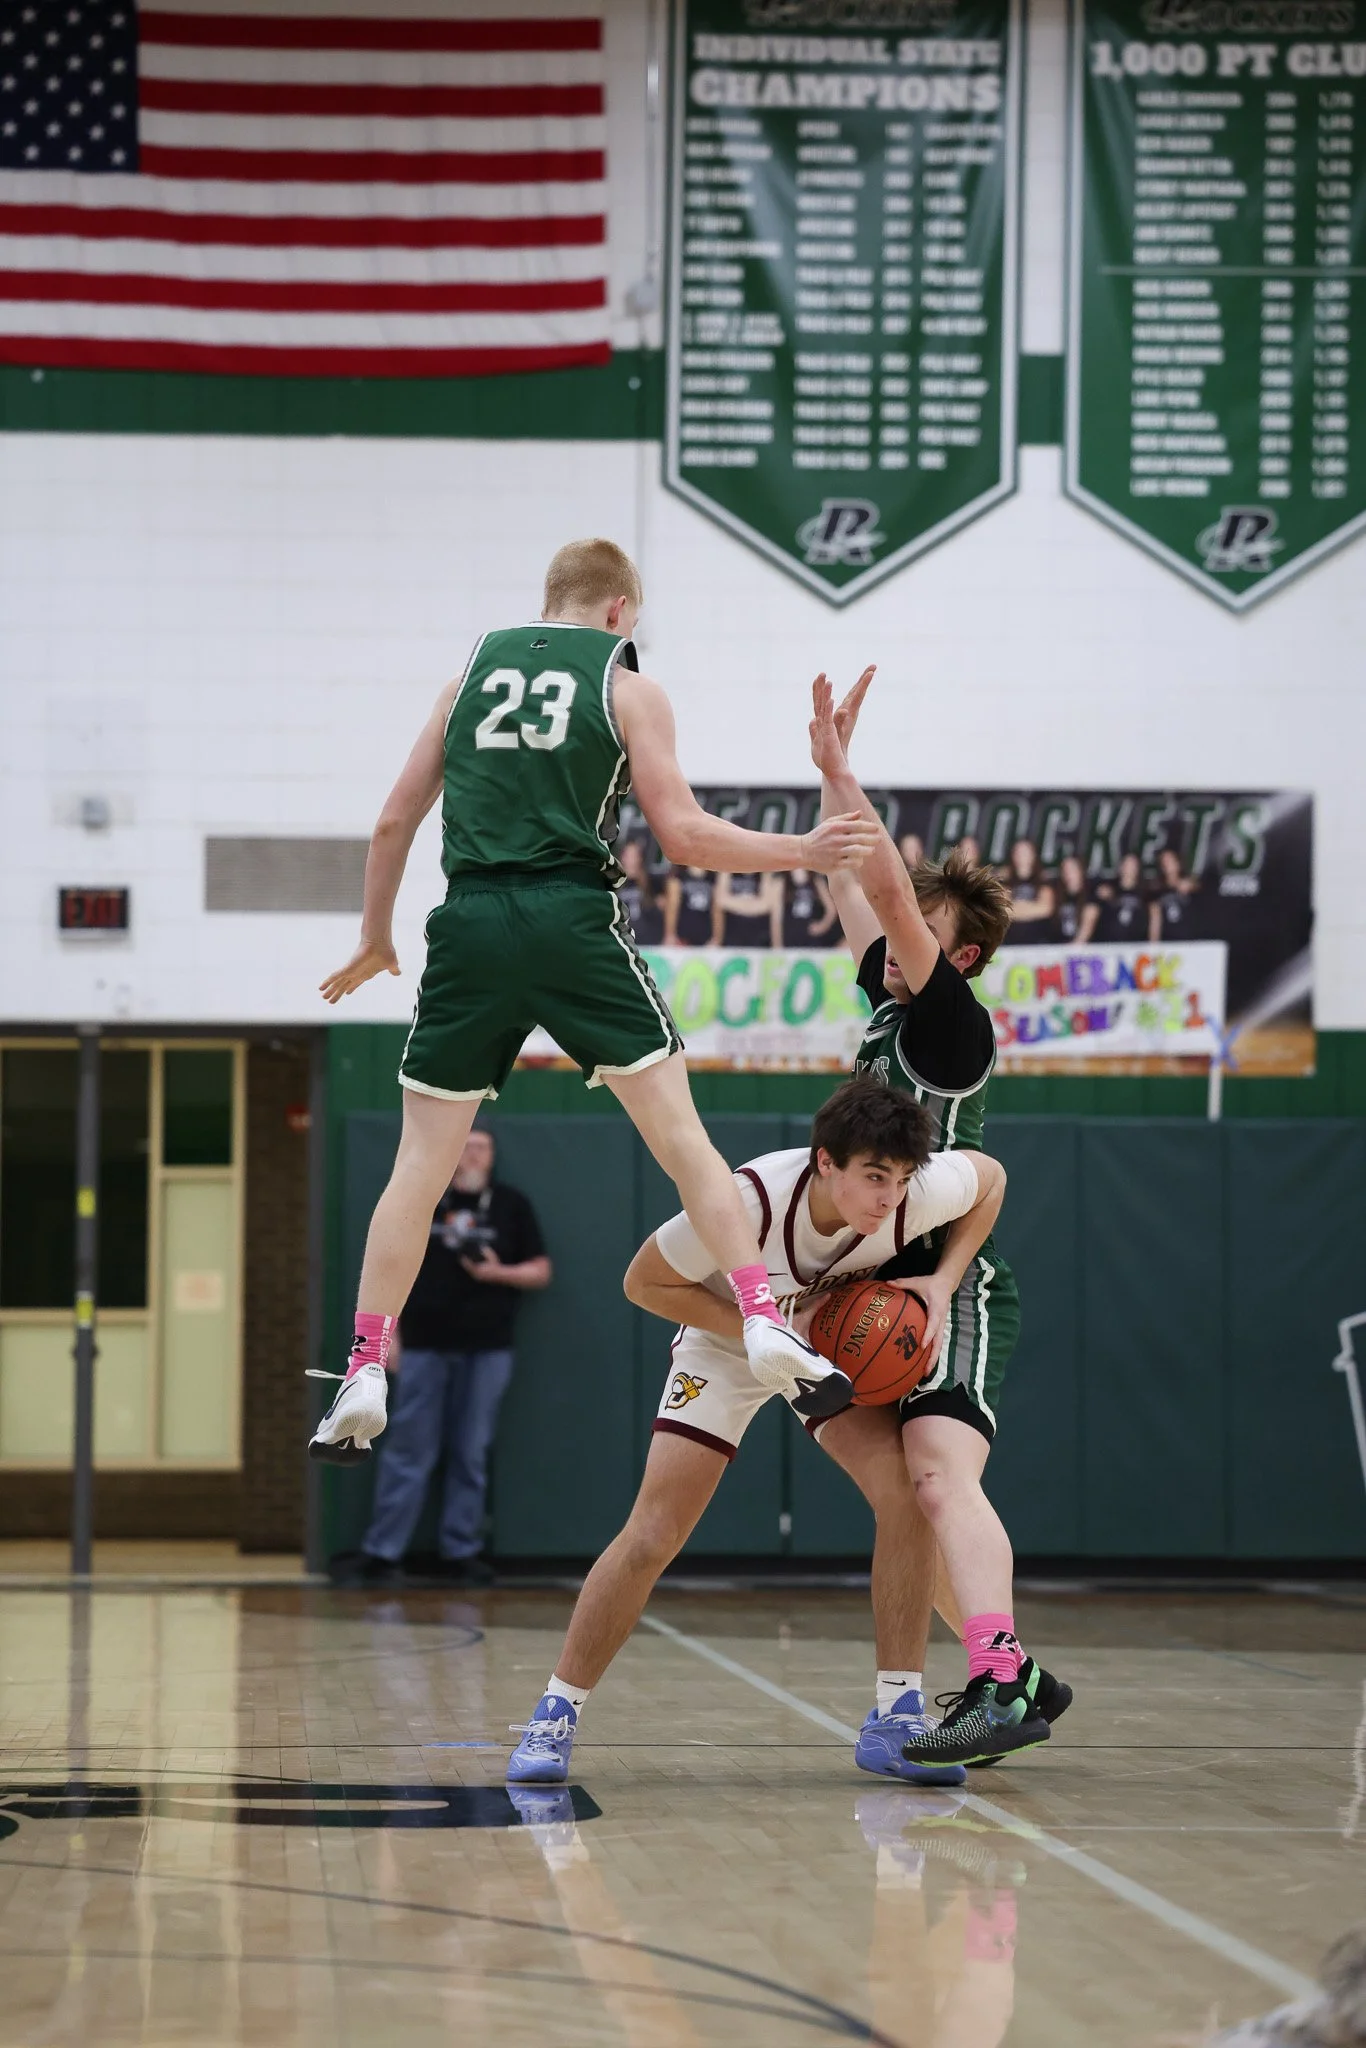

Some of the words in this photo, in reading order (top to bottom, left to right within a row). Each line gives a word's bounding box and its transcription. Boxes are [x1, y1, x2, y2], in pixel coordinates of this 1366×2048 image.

[694, 33, 892, 63] INDIVIDUAL
[899, 39, 1000, 66] STATE
[1091, 41, 1207, 82] 1,000
[1216, 44, 1278, 78] PT
[690, 68, 1001, 112] CHAMPIONS
[475, 667, 579, 752] 23
